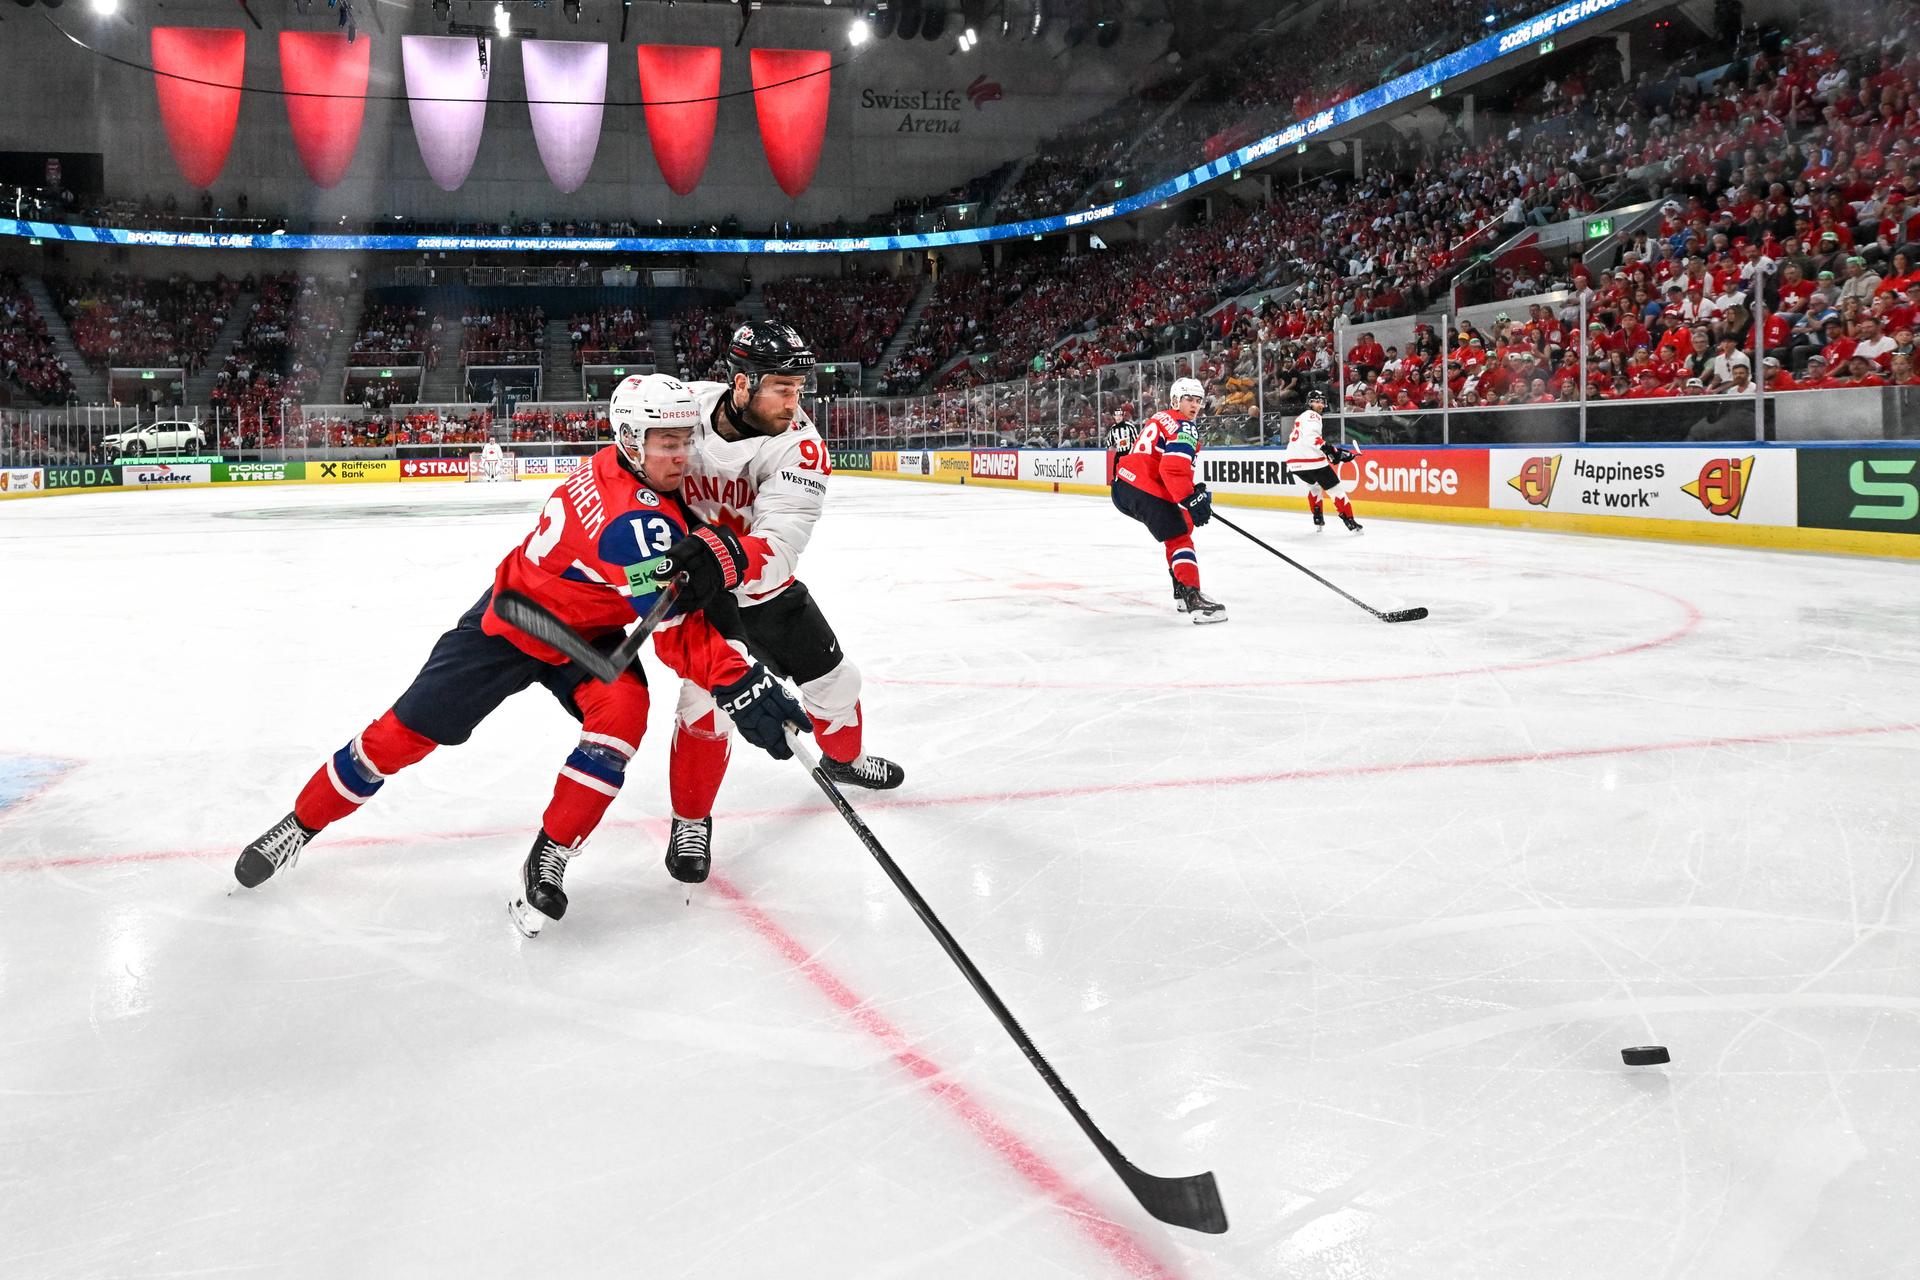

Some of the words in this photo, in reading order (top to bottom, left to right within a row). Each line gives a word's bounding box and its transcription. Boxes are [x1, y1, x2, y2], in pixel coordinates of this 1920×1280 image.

[1499, 25, 1531, 51] 2026
[1556, 3, 1580, 27] ICE
[897, 112, 961, 133] Arena
[1246, 136, 1280, 160] BRONZE
[1279, 123, 1307, 147] MEDAL
[1307, 110, 1335, 132] GAME
[1065, 213, 1084, 226] TIME
[1084, 210, 1094, 221] TO
[1094, 205, 1115, 219] SHINE
[127, 232, 176, 244] BRONZE
[177, 234, 217, 246] MEDAL
[219, 235, 253, 247] GAME
[417, 239, 441, 248] 2026
[460, 239, 477, 248] ICE
[477, 239, 515, 248] HOCKEY
[514, 239, 548, 249] WORLD
[548, 239, 617, 250] CHAMPIONSHIP
[764, 241, 805, 251] BRONZE
[806, 240, 840, 250] MEDAL
[842, 239, 870, 249] GAME
[341, 461, 387, 470] Raiffeisen
[525, 459, 547, 467] LIQUI
[798, 440, 833, 476] 90
[905, 455, 920, 465] TISSOT
[940, 457, 969, 471] PostFinance
[973, 453, 1016, 477] DENNER
[229, 472, 285, 481] TYRES
[525, 466, 547, 474] MOLY
[1203, 461, 1296, 485] LIEBHERR
[1364, 458, 1459, 495] Sunrise
[1574, 459, 1665, 485] Happiness
[683, 475, 758, 510] ANAD
[1582, 489, 1600, 506] at
[629, 517, 672, 558] 13
[692, 526, 738, 589] WARRIOR
[722, 675, 773, 716] CCM
